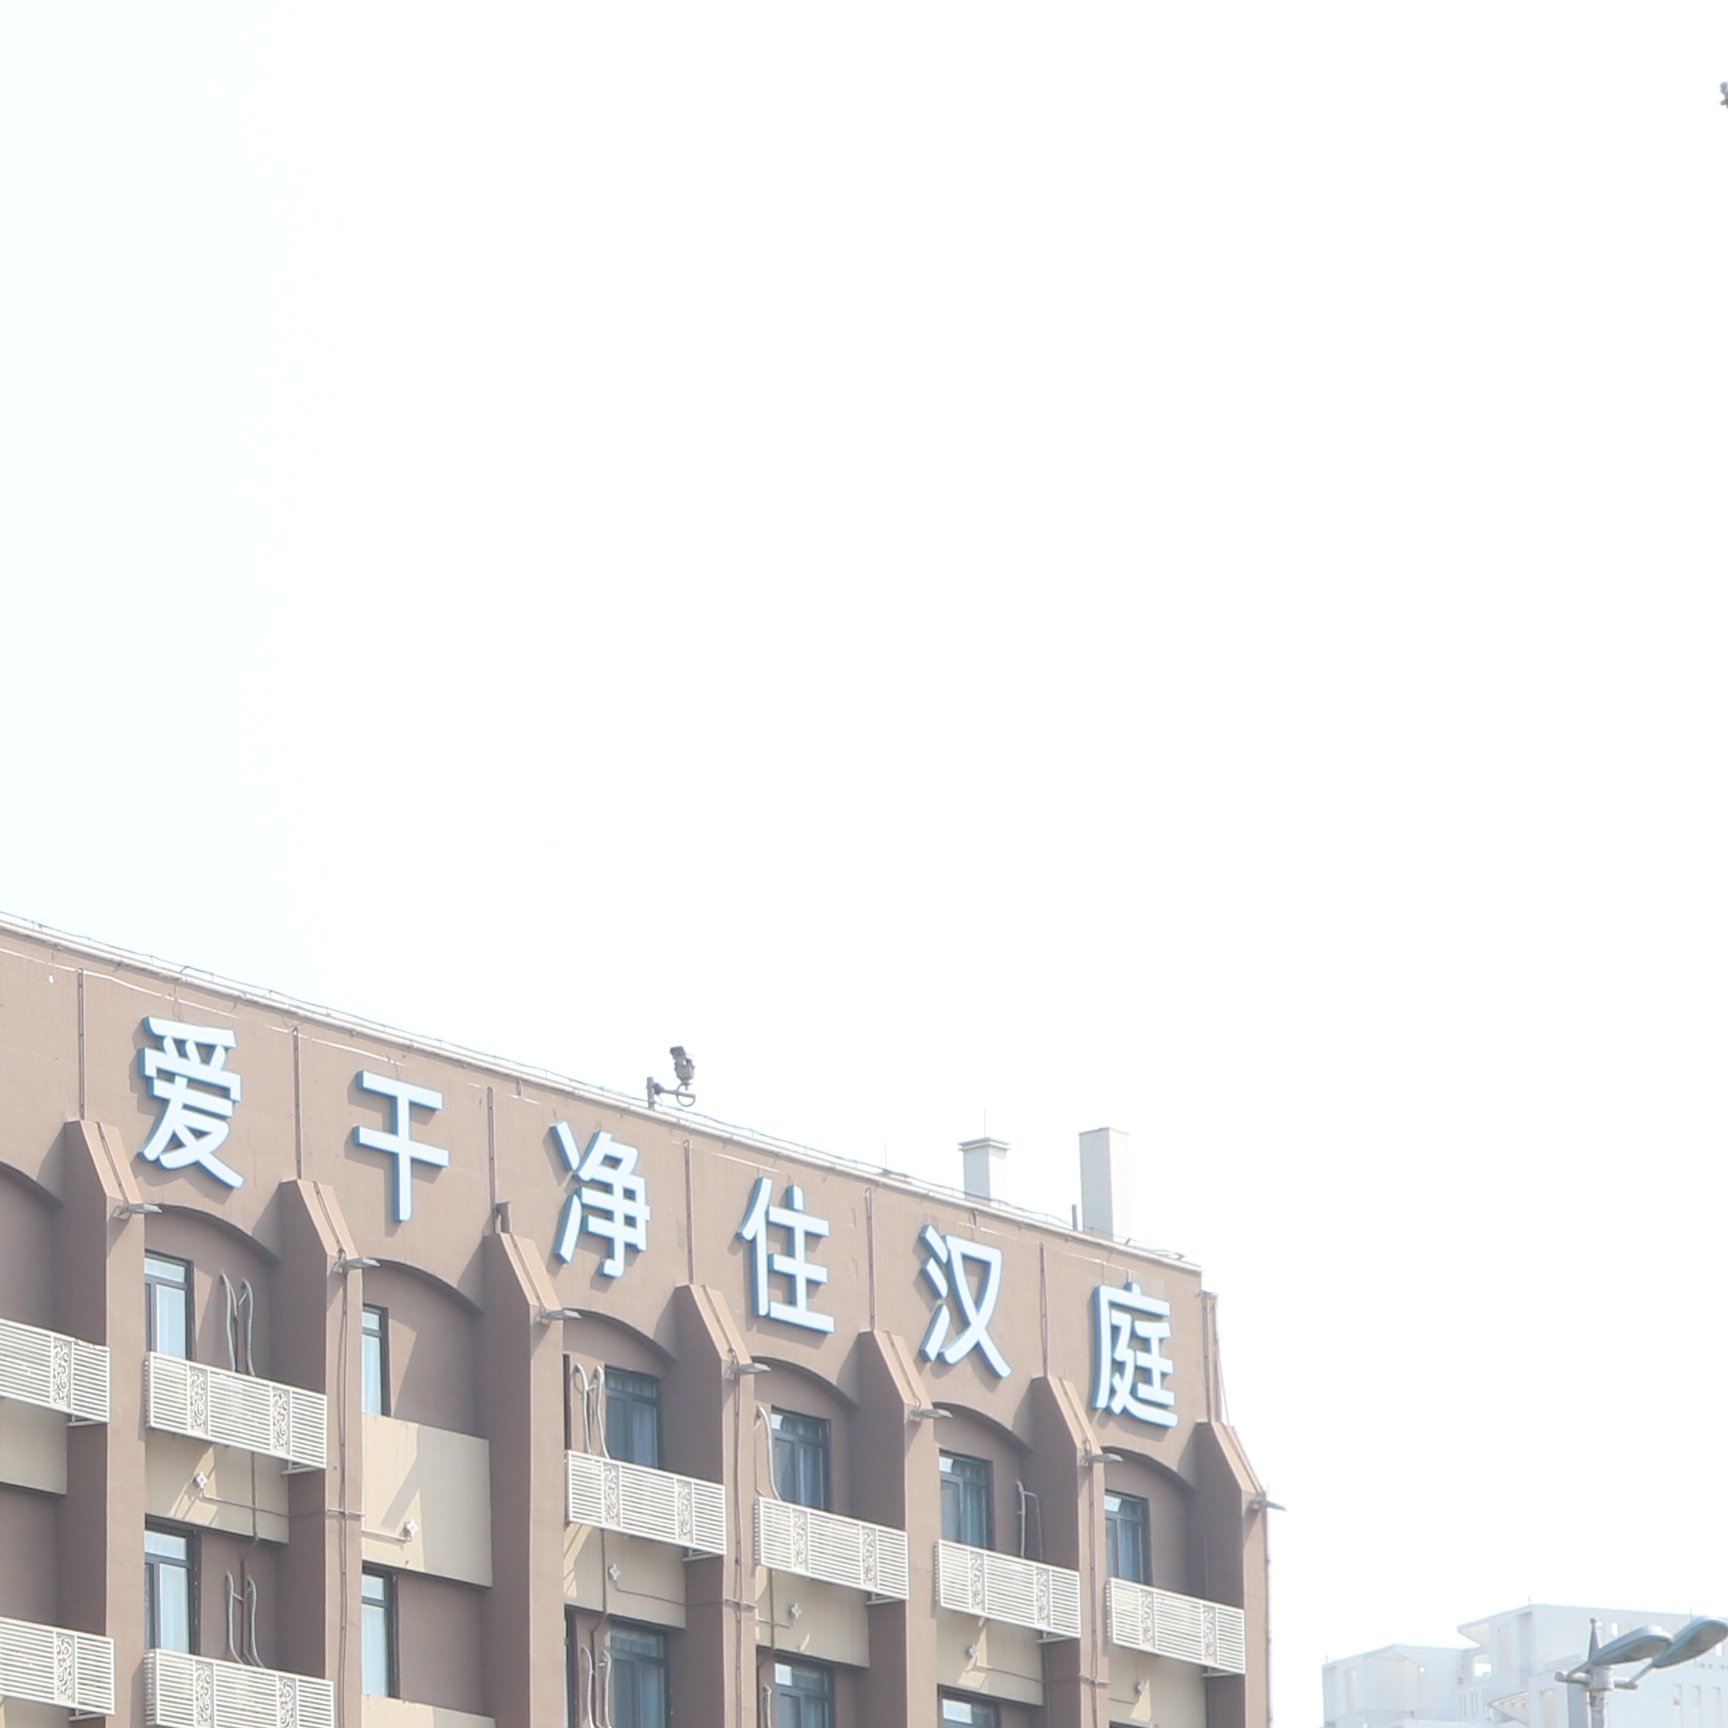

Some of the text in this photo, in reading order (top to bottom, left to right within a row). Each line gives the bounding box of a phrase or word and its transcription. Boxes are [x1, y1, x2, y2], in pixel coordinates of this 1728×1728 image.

[139, 1014, 1179, 1429] 爱干净住汉庭
